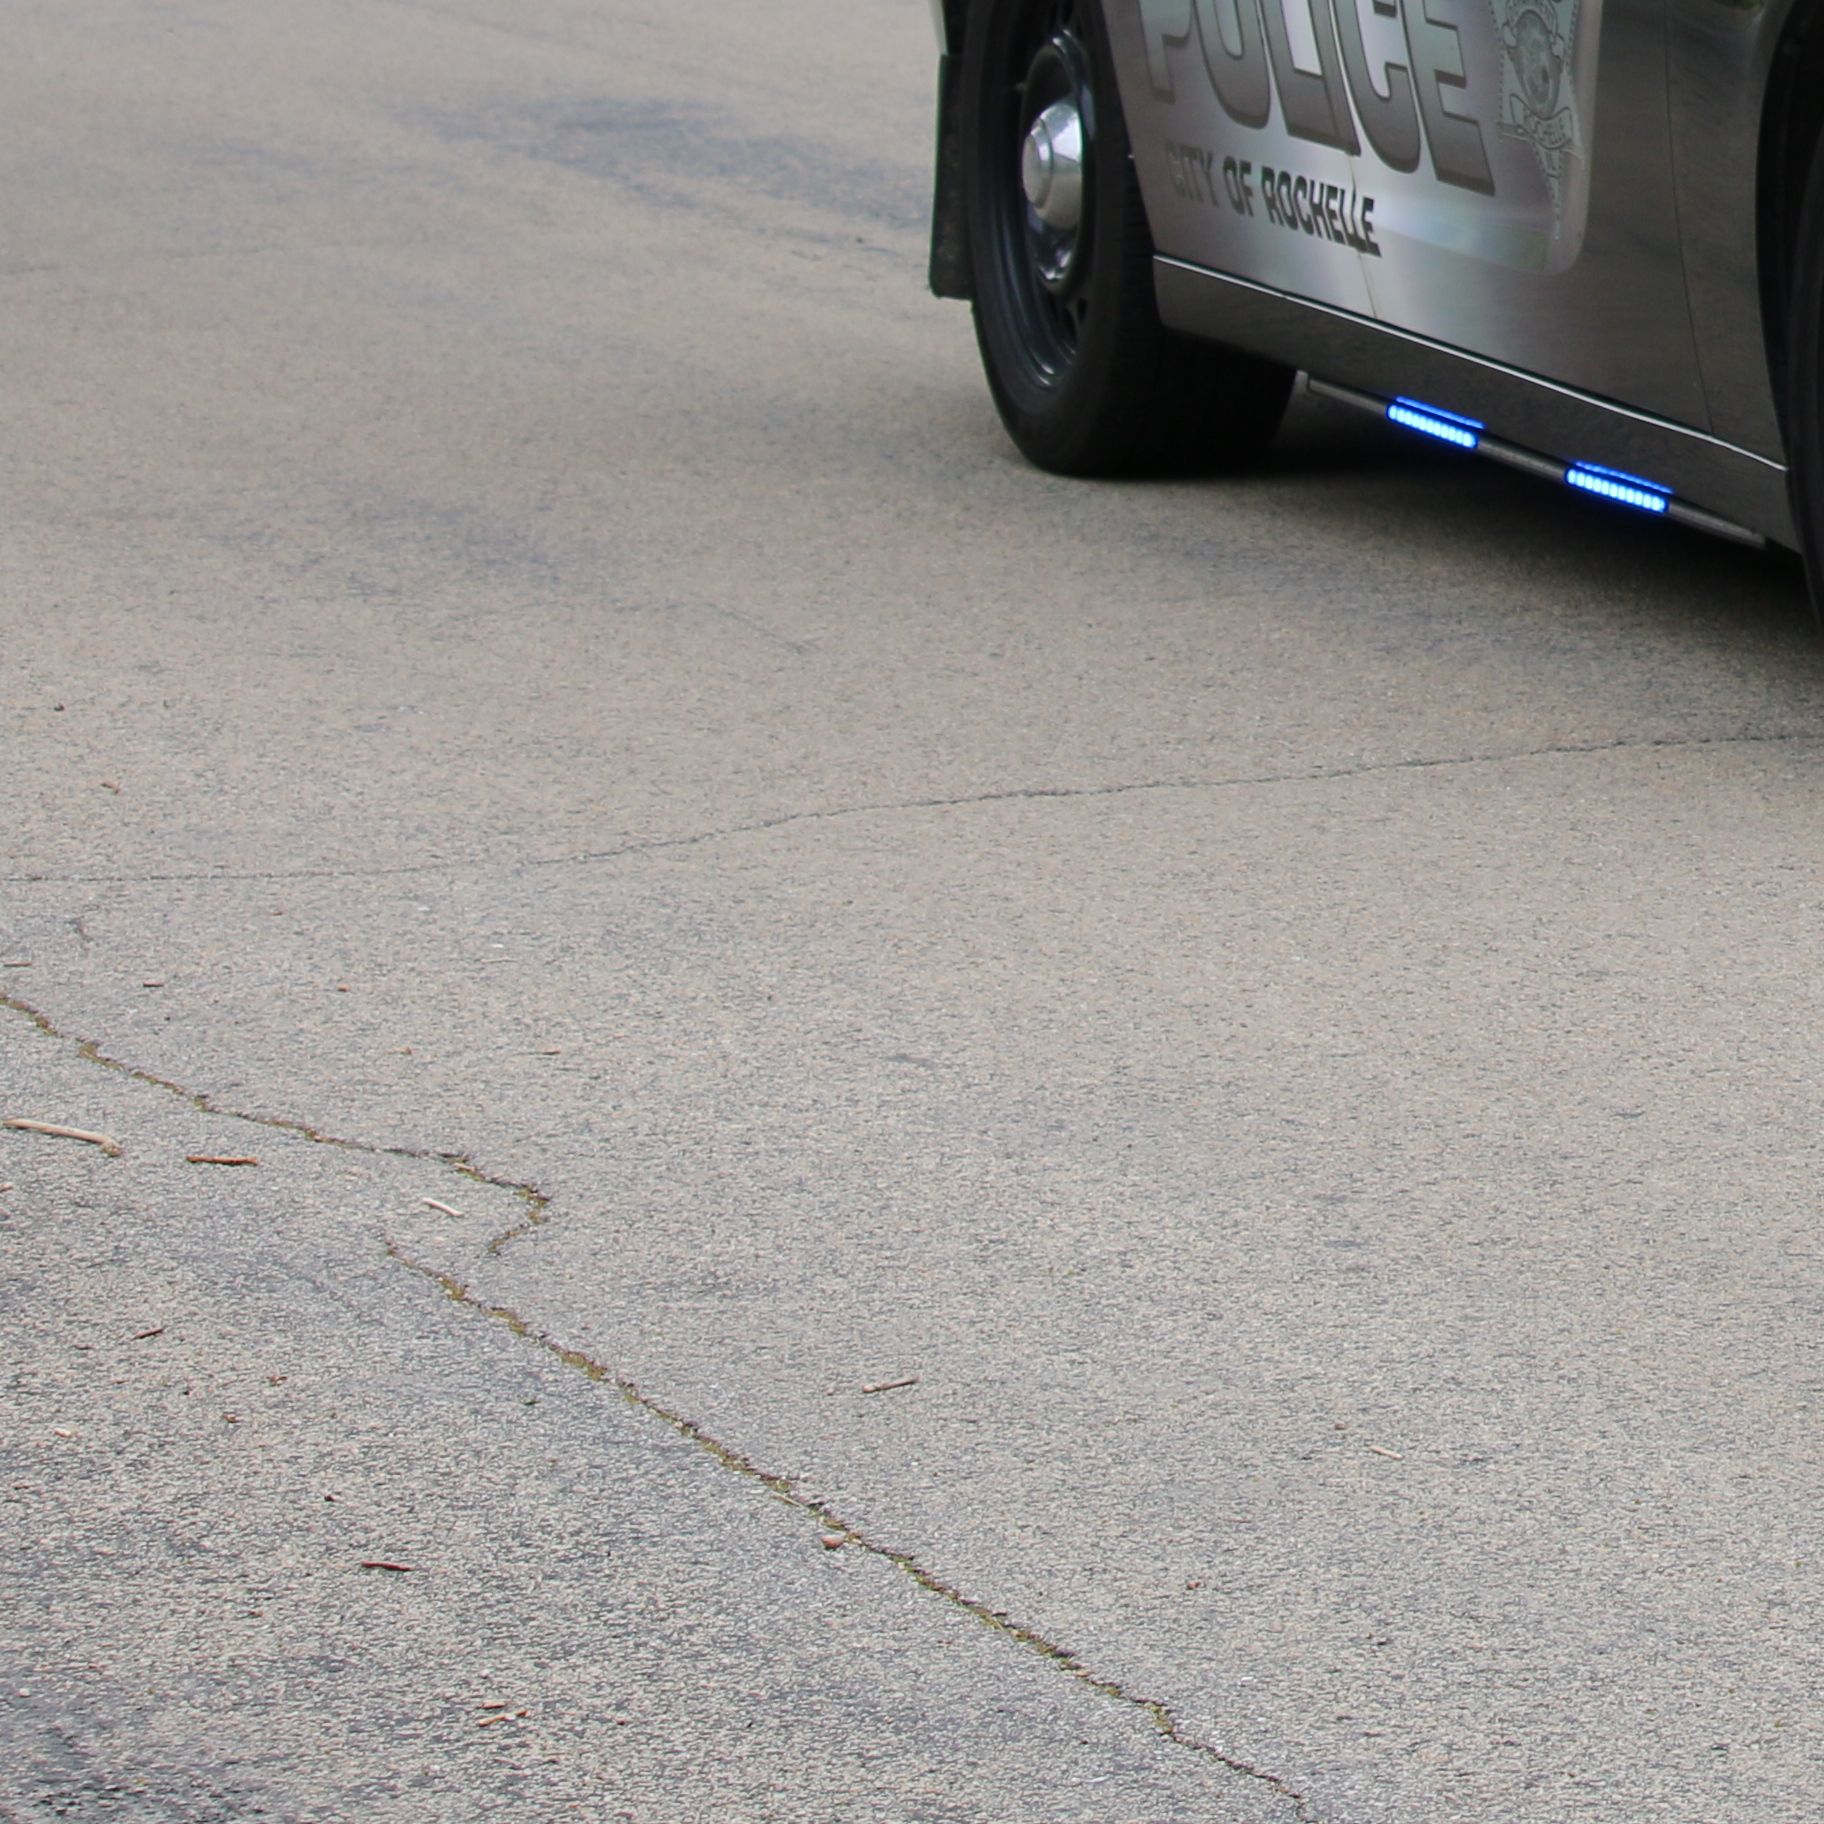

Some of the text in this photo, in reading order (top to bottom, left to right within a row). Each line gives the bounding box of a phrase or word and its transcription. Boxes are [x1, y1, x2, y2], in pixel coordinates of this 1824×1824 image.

[1165, 142, 1382, 257] CITY OF ROCHELLE
